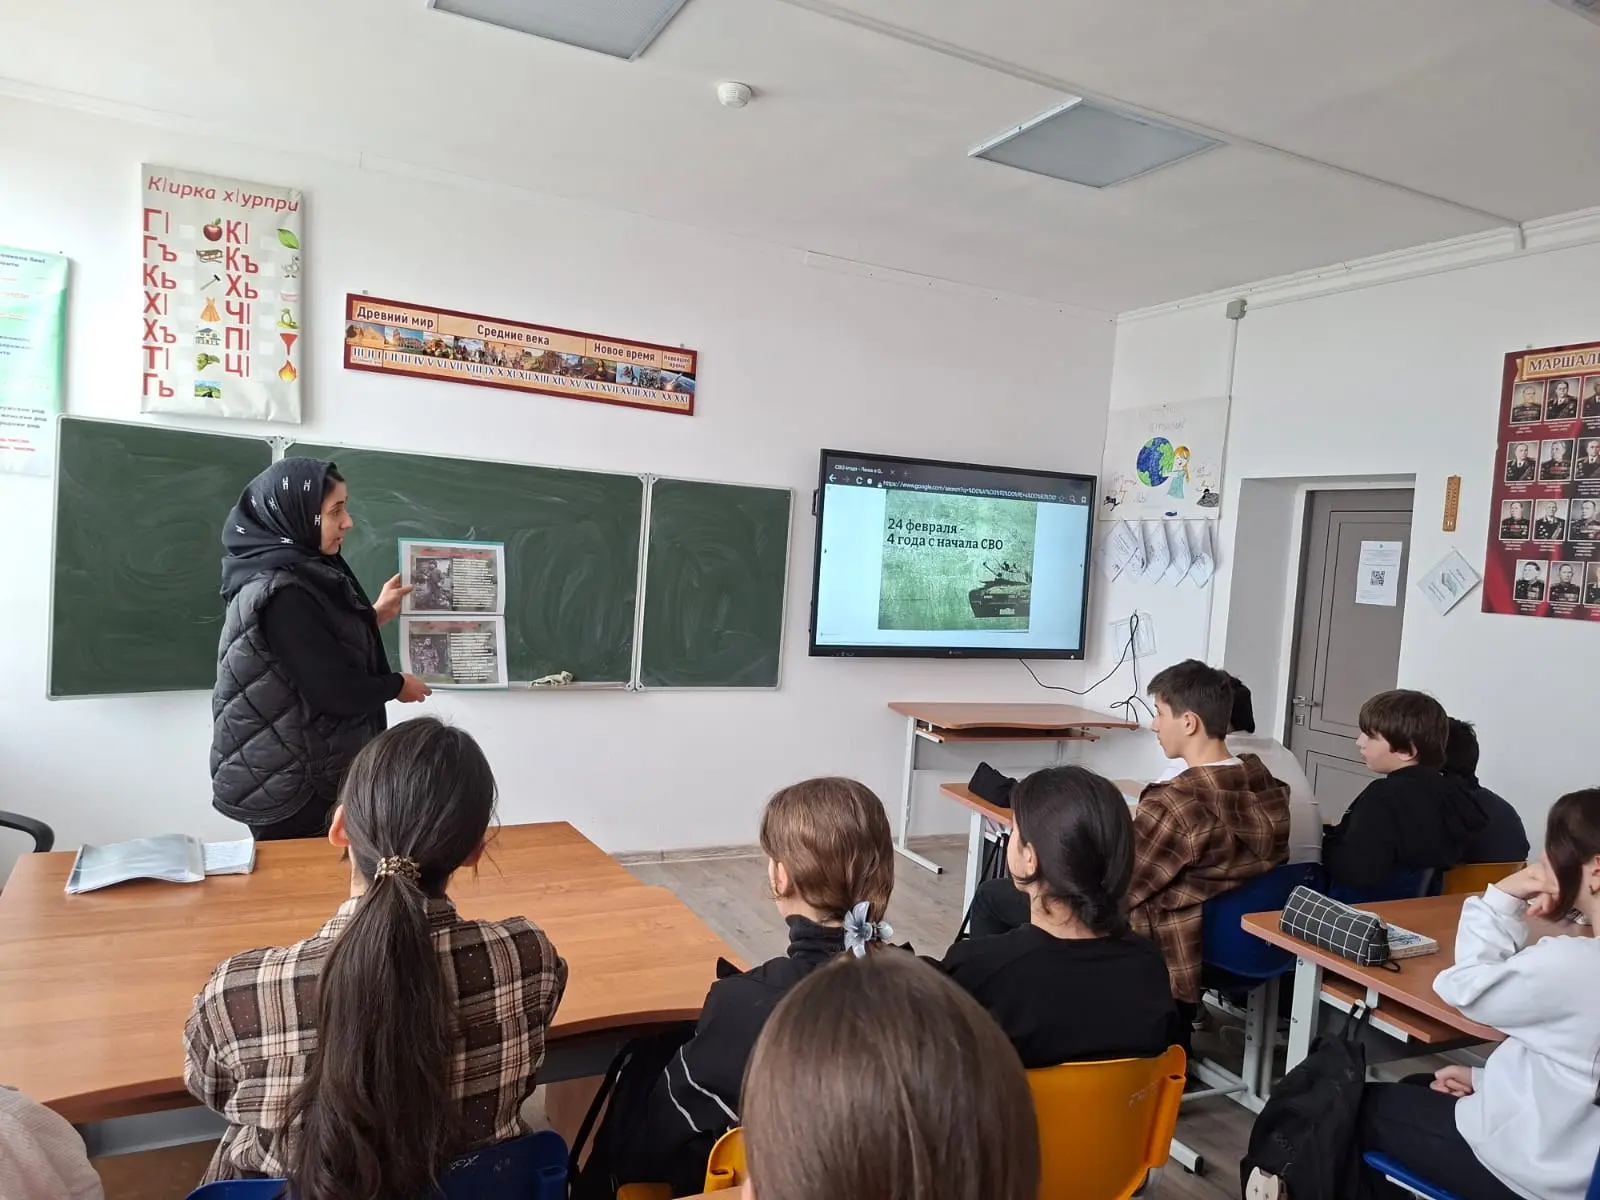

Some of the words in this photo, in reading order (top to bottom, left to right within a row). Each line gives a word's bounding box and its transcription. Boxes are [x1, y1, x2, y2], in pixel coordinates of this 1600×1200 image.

[143, 235, 177, 262] Гъ
[225, 246, 259, 273] Къ
[143, 263, 177, 289] Кь
[225, 274, 258, 299] Хь
[357, 306, 408, 324] Древний
[411, 317, 434, 329] мир
[143, 318, 177, 343] Хъ
[477, 324, 523, 341] Средние
[526, 333, 550, 346] века
[594, 343, 624, 357] Новое
[626, 348, 655, 362] время
[143, 372, 174, 397] Гь
[888, 519, 902, 530] 24
[905, 519, 957, 534] февраля
[886, 533, 895, 544] 4
[897, 536, 926, 547] года
[928, 538, 935, 547] с
[937, 538, 979, 549] начала
[980, 538, 1003, 550] СВО
